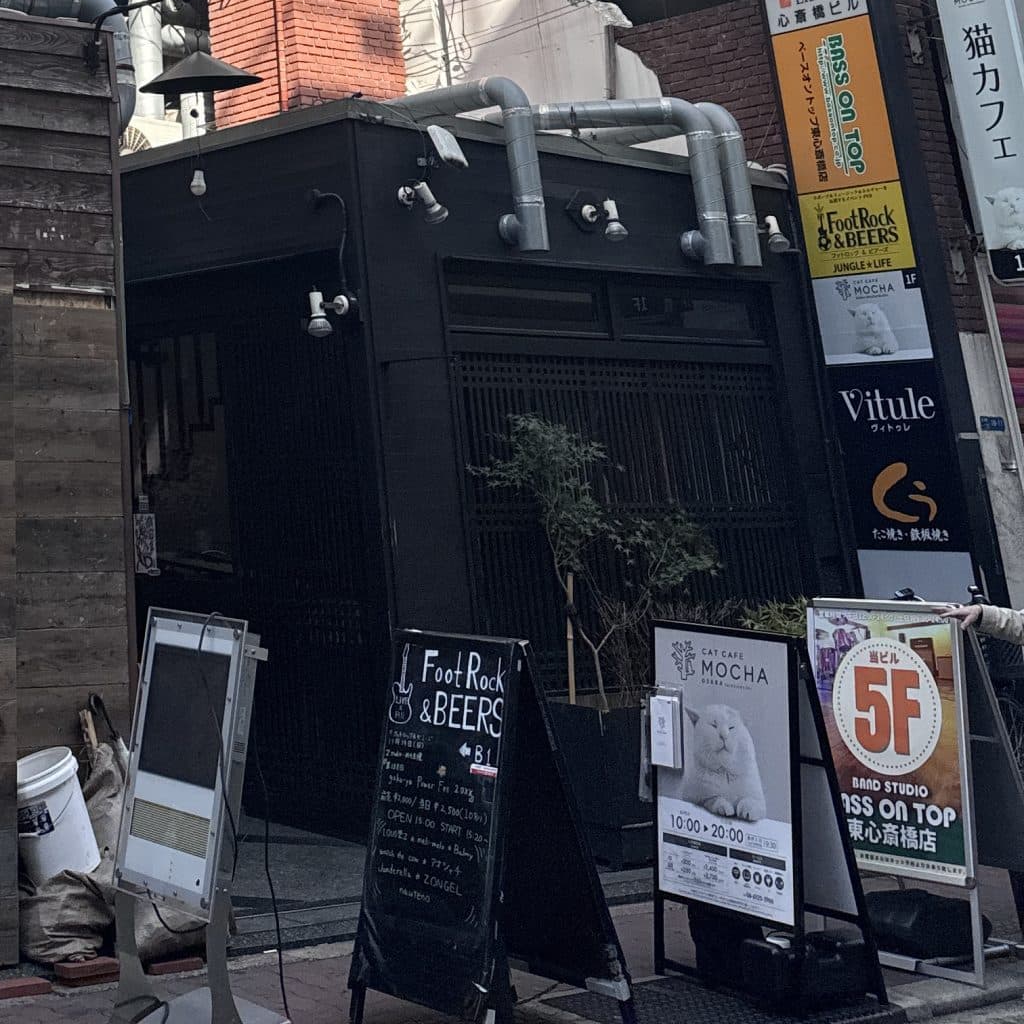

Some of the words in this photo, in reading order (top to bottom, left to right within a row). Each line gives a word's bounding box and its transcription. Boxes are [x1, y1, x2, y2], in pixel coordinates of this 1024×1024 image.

[828, 34, 850, 86] BASS
[838, 90, 857, 123] ON
[962, 23, 1017, 159] 猫カフェ
[845, 128, 865, 173] TOP
[834, 226, 899, 249] &BEERS
[854, 283, 895, 295] MOCHA
[905, 273, 917, 285] 1F
[838, 387, 936, 422] Vitule
[701, 648, 718, 656] CAT
[722, 650, 744, 660] CAFE
[869, 650, 900, 664] 当ビル
[701, 659, 768, 685] MOCHA
[419, 691, 504, 737] &BEERS
[854, 665, 921, 756] 5F
[852, 776, 881, 792] BAND
[884, 782, 929, 798] STUDIO
[387, 808, 413, 824] OPEN
[440, 822, 462, 836] START
[841, 793, 874, 817] ASS
[879, 799, 908, 822] ON
[912, 803, 957, 828] TOP
[671, 814, 700, 833] 10:00
[712, 823, 744, 843] 20:00
[847, 817, 937, 853] 東心斎橋店
